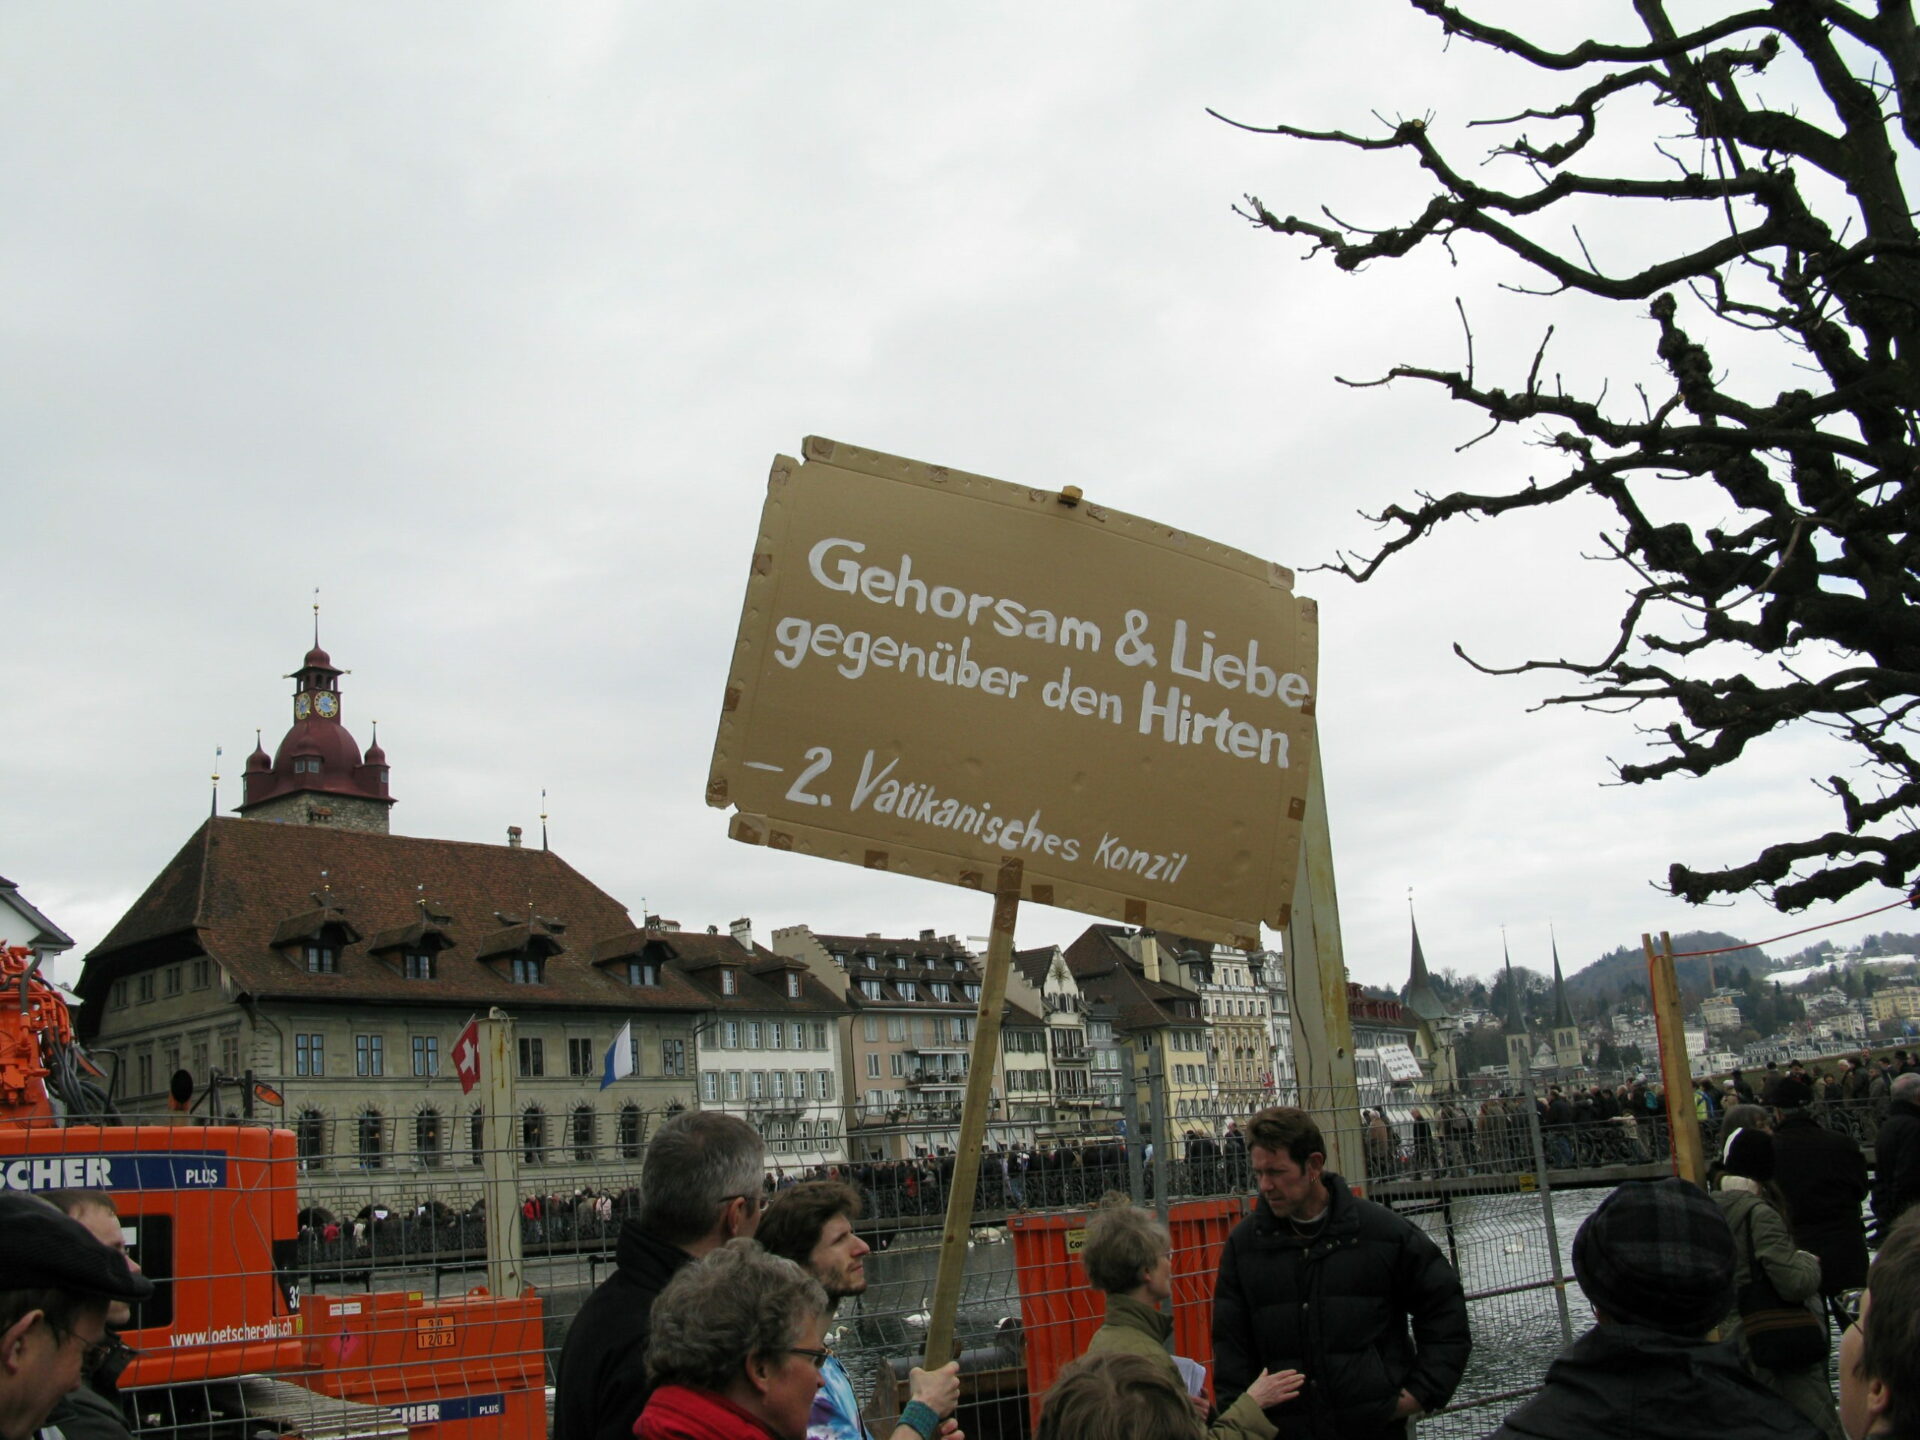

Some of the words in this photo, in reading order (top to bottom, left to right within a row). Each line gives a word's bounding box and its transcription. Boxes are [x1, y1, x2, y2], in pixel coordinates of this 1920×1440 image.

[808, 538, 1101, 652] Gehorsam
[1115, 609, 1157, 668] &
[1171, 620, 1309, 707] Liebe
[774, 617, 1028, 698] gegenüber
[1042, 667, 1122, 724] den
[1139, 681, 1289, 768] Hirten
[785, 747, 831, 807] 2.
[850, 750, 1080, 862] Vatikanisches
[1093, 833, 1187, 883] Konzil
[186, 1169, 218, 1184] PLUS
[421, 1333, 452, 1347] 1202
[479, 1405, 499, 1415] PLUS
